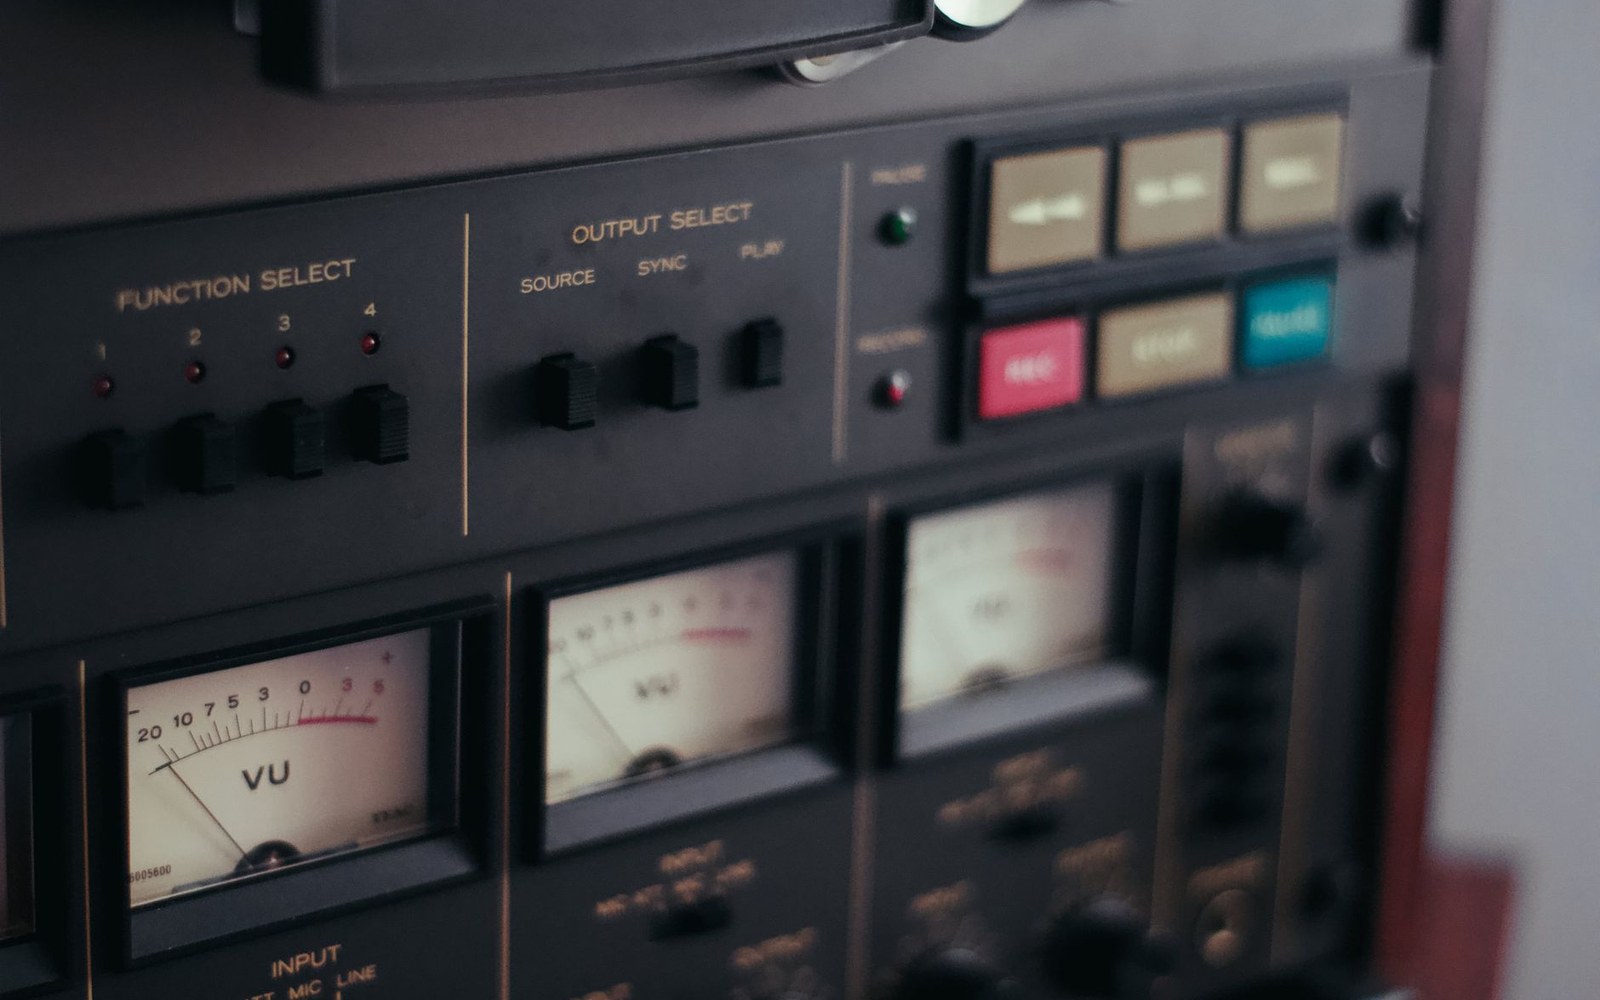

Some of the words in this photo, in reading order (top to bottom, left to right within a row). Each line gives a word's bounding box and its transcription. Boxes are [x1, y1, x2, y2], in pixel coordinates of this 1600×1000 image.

[572, 215, 661, 245] OUTPUT
[671, 203, 753, 230] SELECT
[638, 255, 688, 276] SYNC
[740, 240, 784, 260] PLAY
[117, 274, 251, 312] FUNCTION
[260, 259, 356, 291] SELECT
[520, 269, 596, 293] SOURCE
[189, 328, 202, 346] 2
[278, 315, 291, 332] 3
[363, 302, 377, 318] 4
[138, 725, 162, 743] 20
[173, 712, 193, 728] 10
[204, 702, 215, 717] 7
[227, 694, 240, 709] 5
[258, 686, 270, 702] 3
[299, 680, 311, 695] 0
[242, 760, 290, 791] VU
[271, 944, 342, 978] INPUT
[289, 979, 322, 1000] MIC
[337, 964, 377, 988] LINE
